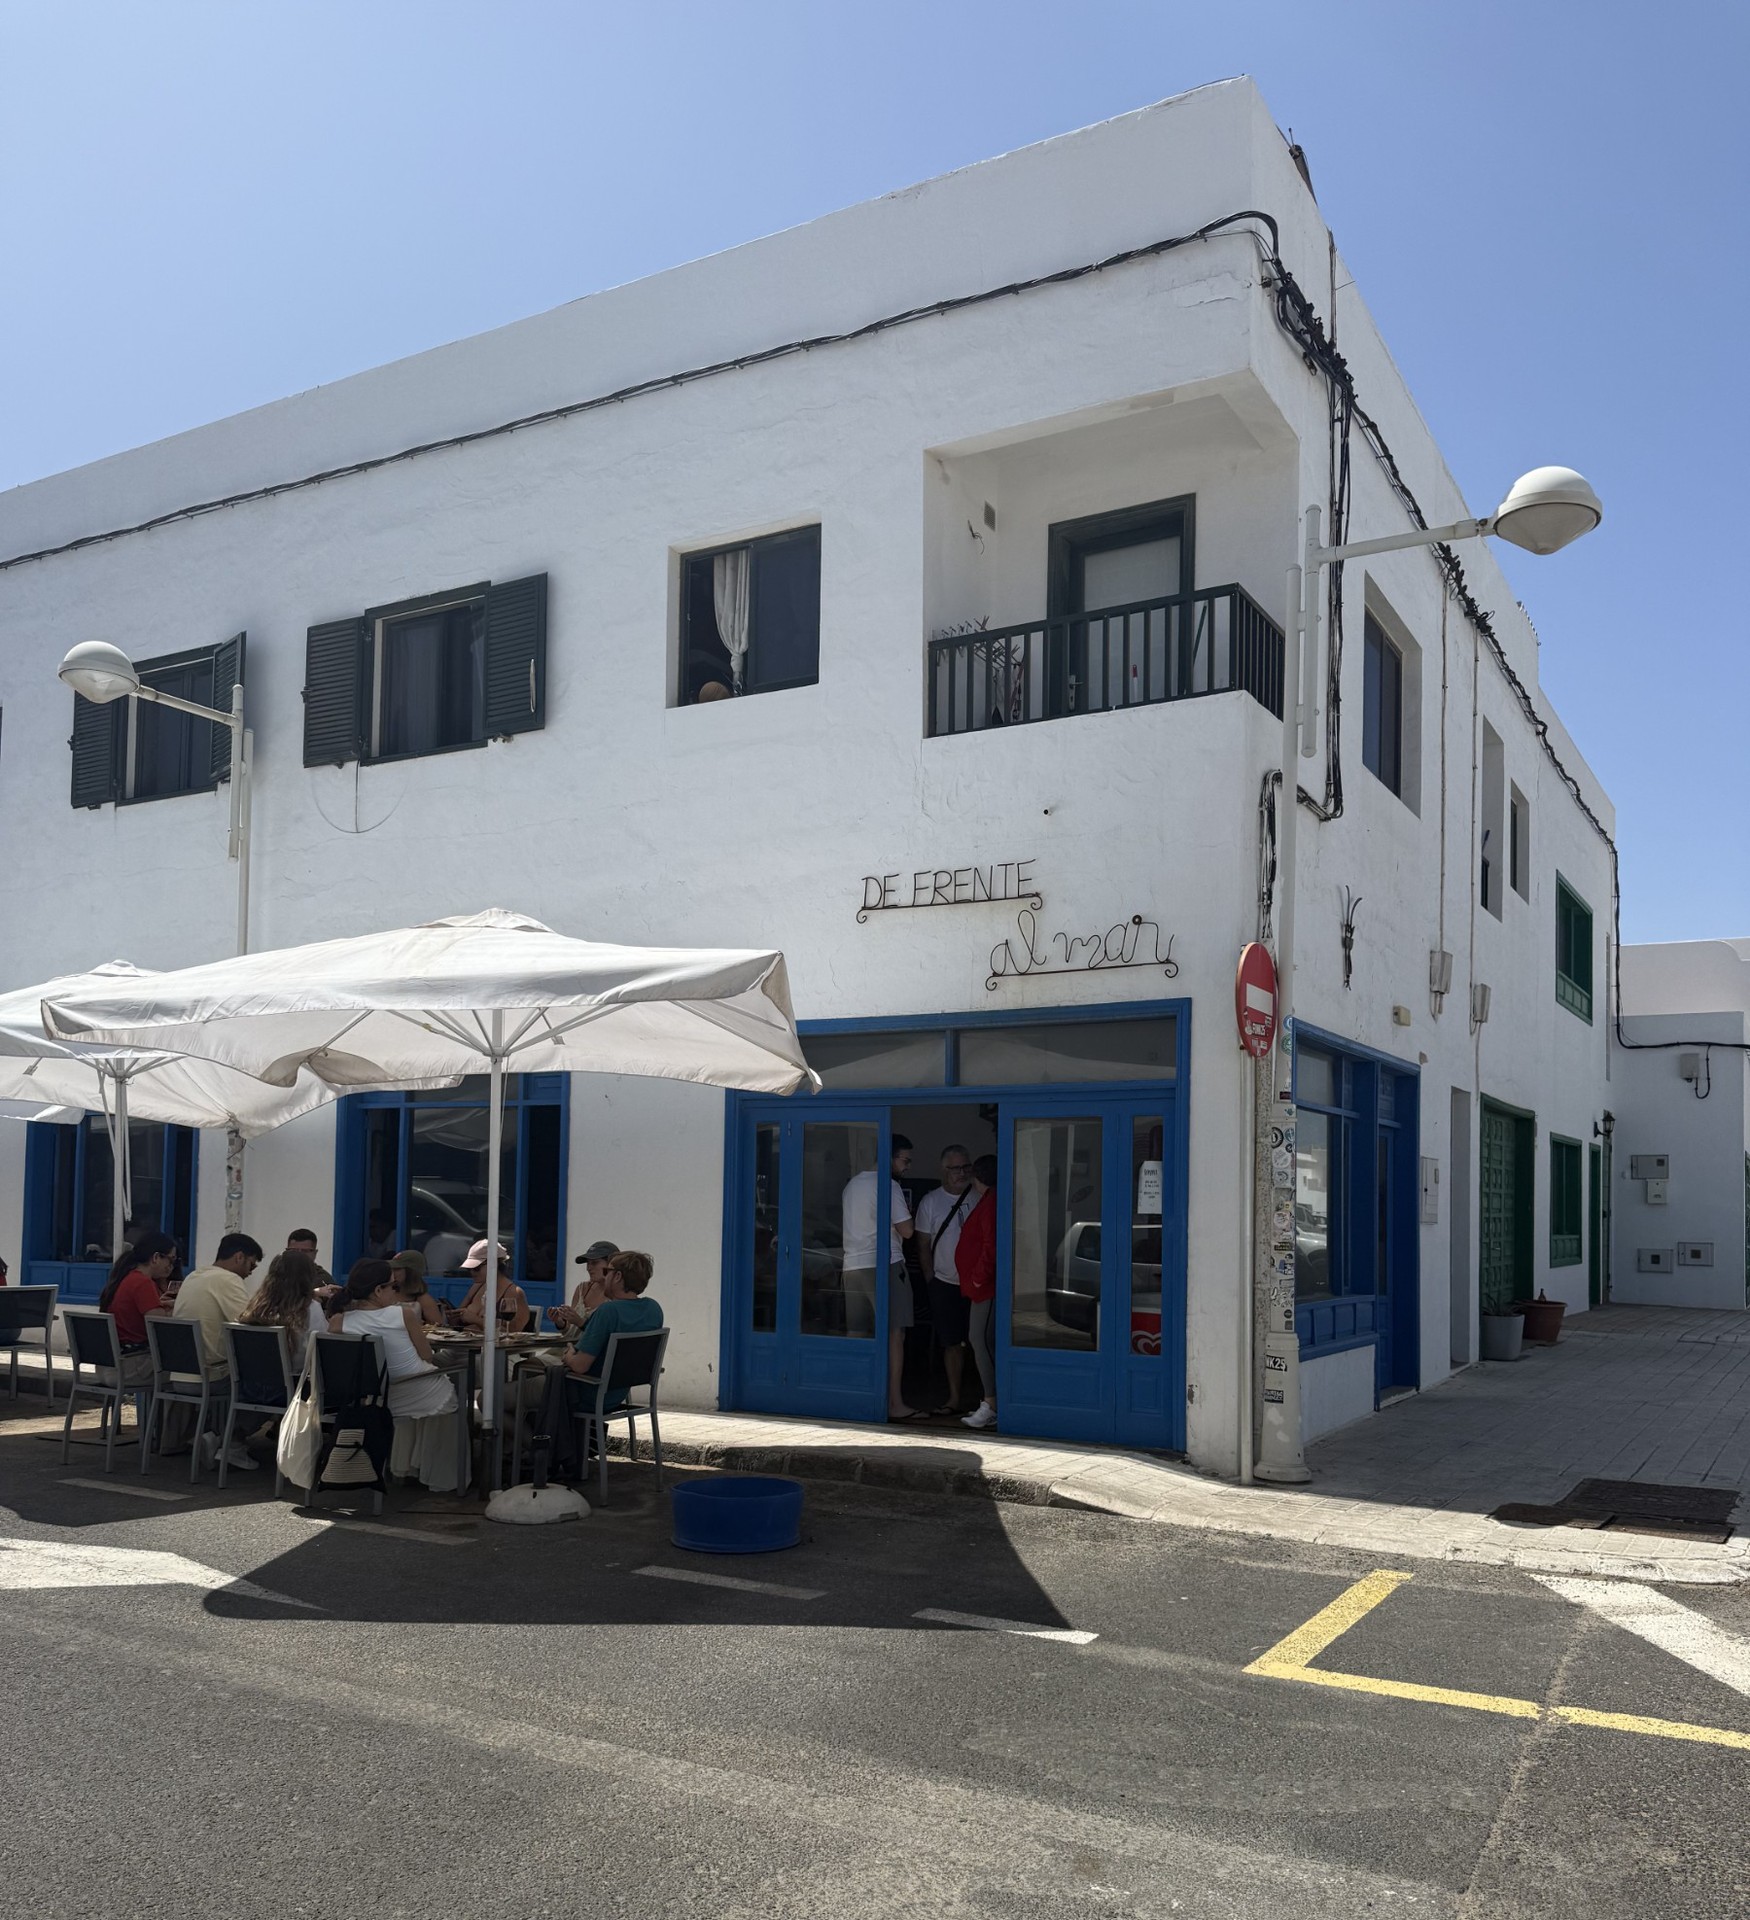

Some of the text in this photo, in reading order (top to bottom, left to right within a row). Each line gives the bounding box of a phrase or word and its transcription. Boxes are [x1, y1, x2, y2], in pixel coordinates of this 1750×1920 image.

[861, 859, 1037, 909] DE FRENTE
[990, 910, 1175, 975] al mar
